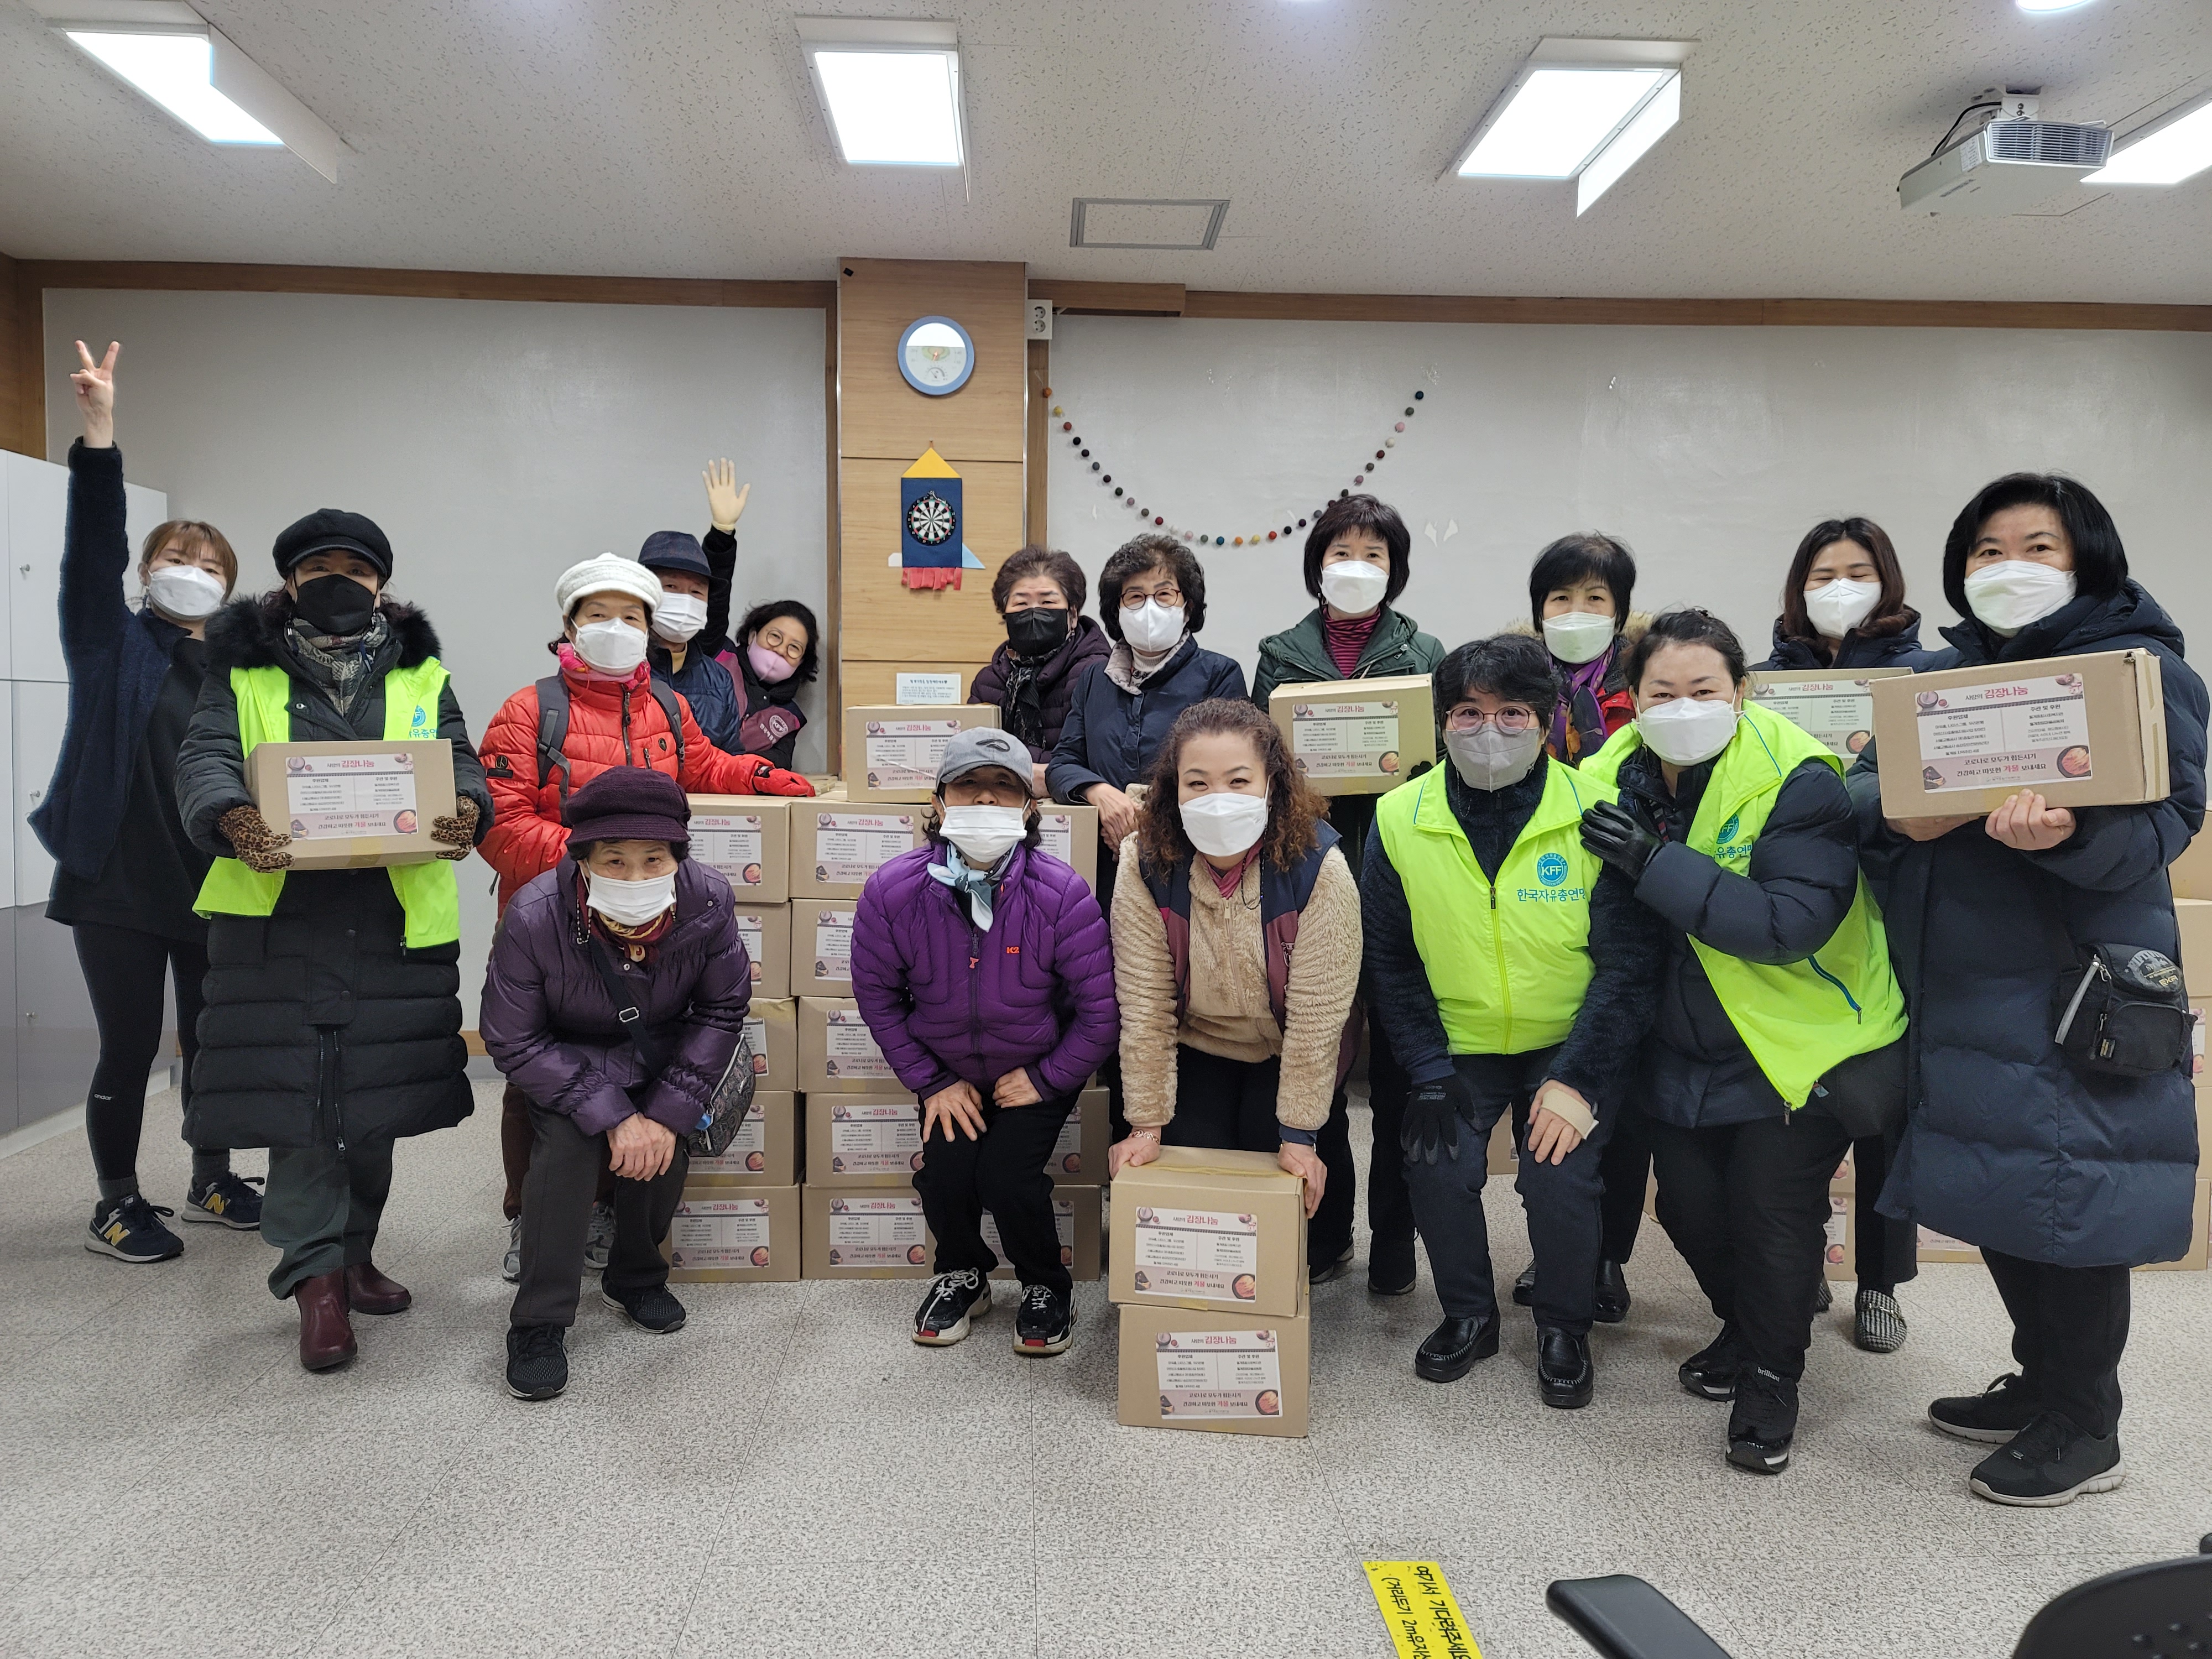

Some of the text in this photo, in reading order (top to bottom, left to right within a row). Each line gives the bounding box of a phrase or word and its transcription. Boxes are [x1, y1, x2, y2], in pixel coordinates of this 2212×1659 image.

[1983, 684, 2028, 699] 김장나눔
[341, 759, 375, 768] 김장나눔
[1963, 758, 1989, 766] 코로나로
[1956, 769, 1982, 778] 건강하고
[2002, 764, 2020, 774] 겨울
[2020, 763, 2046, 771] 보내세요
[1720, 823, 1734, 833] FF
[1714, 844, 1752, 859] 유총연
[1541, 865, 1562, 876] KFF
[1186, 1214, 1218, 1225] 김장나눔
[103, 1221, 131, 1246] N
[1204, 1335, 1237, 1344] 김장나눔
[1757, 1366, 1780, 1383] brilliant
[1413, 1566, 1442, 1595] 여기서
[1381, 1577, 1413, 1614] (거리두기
